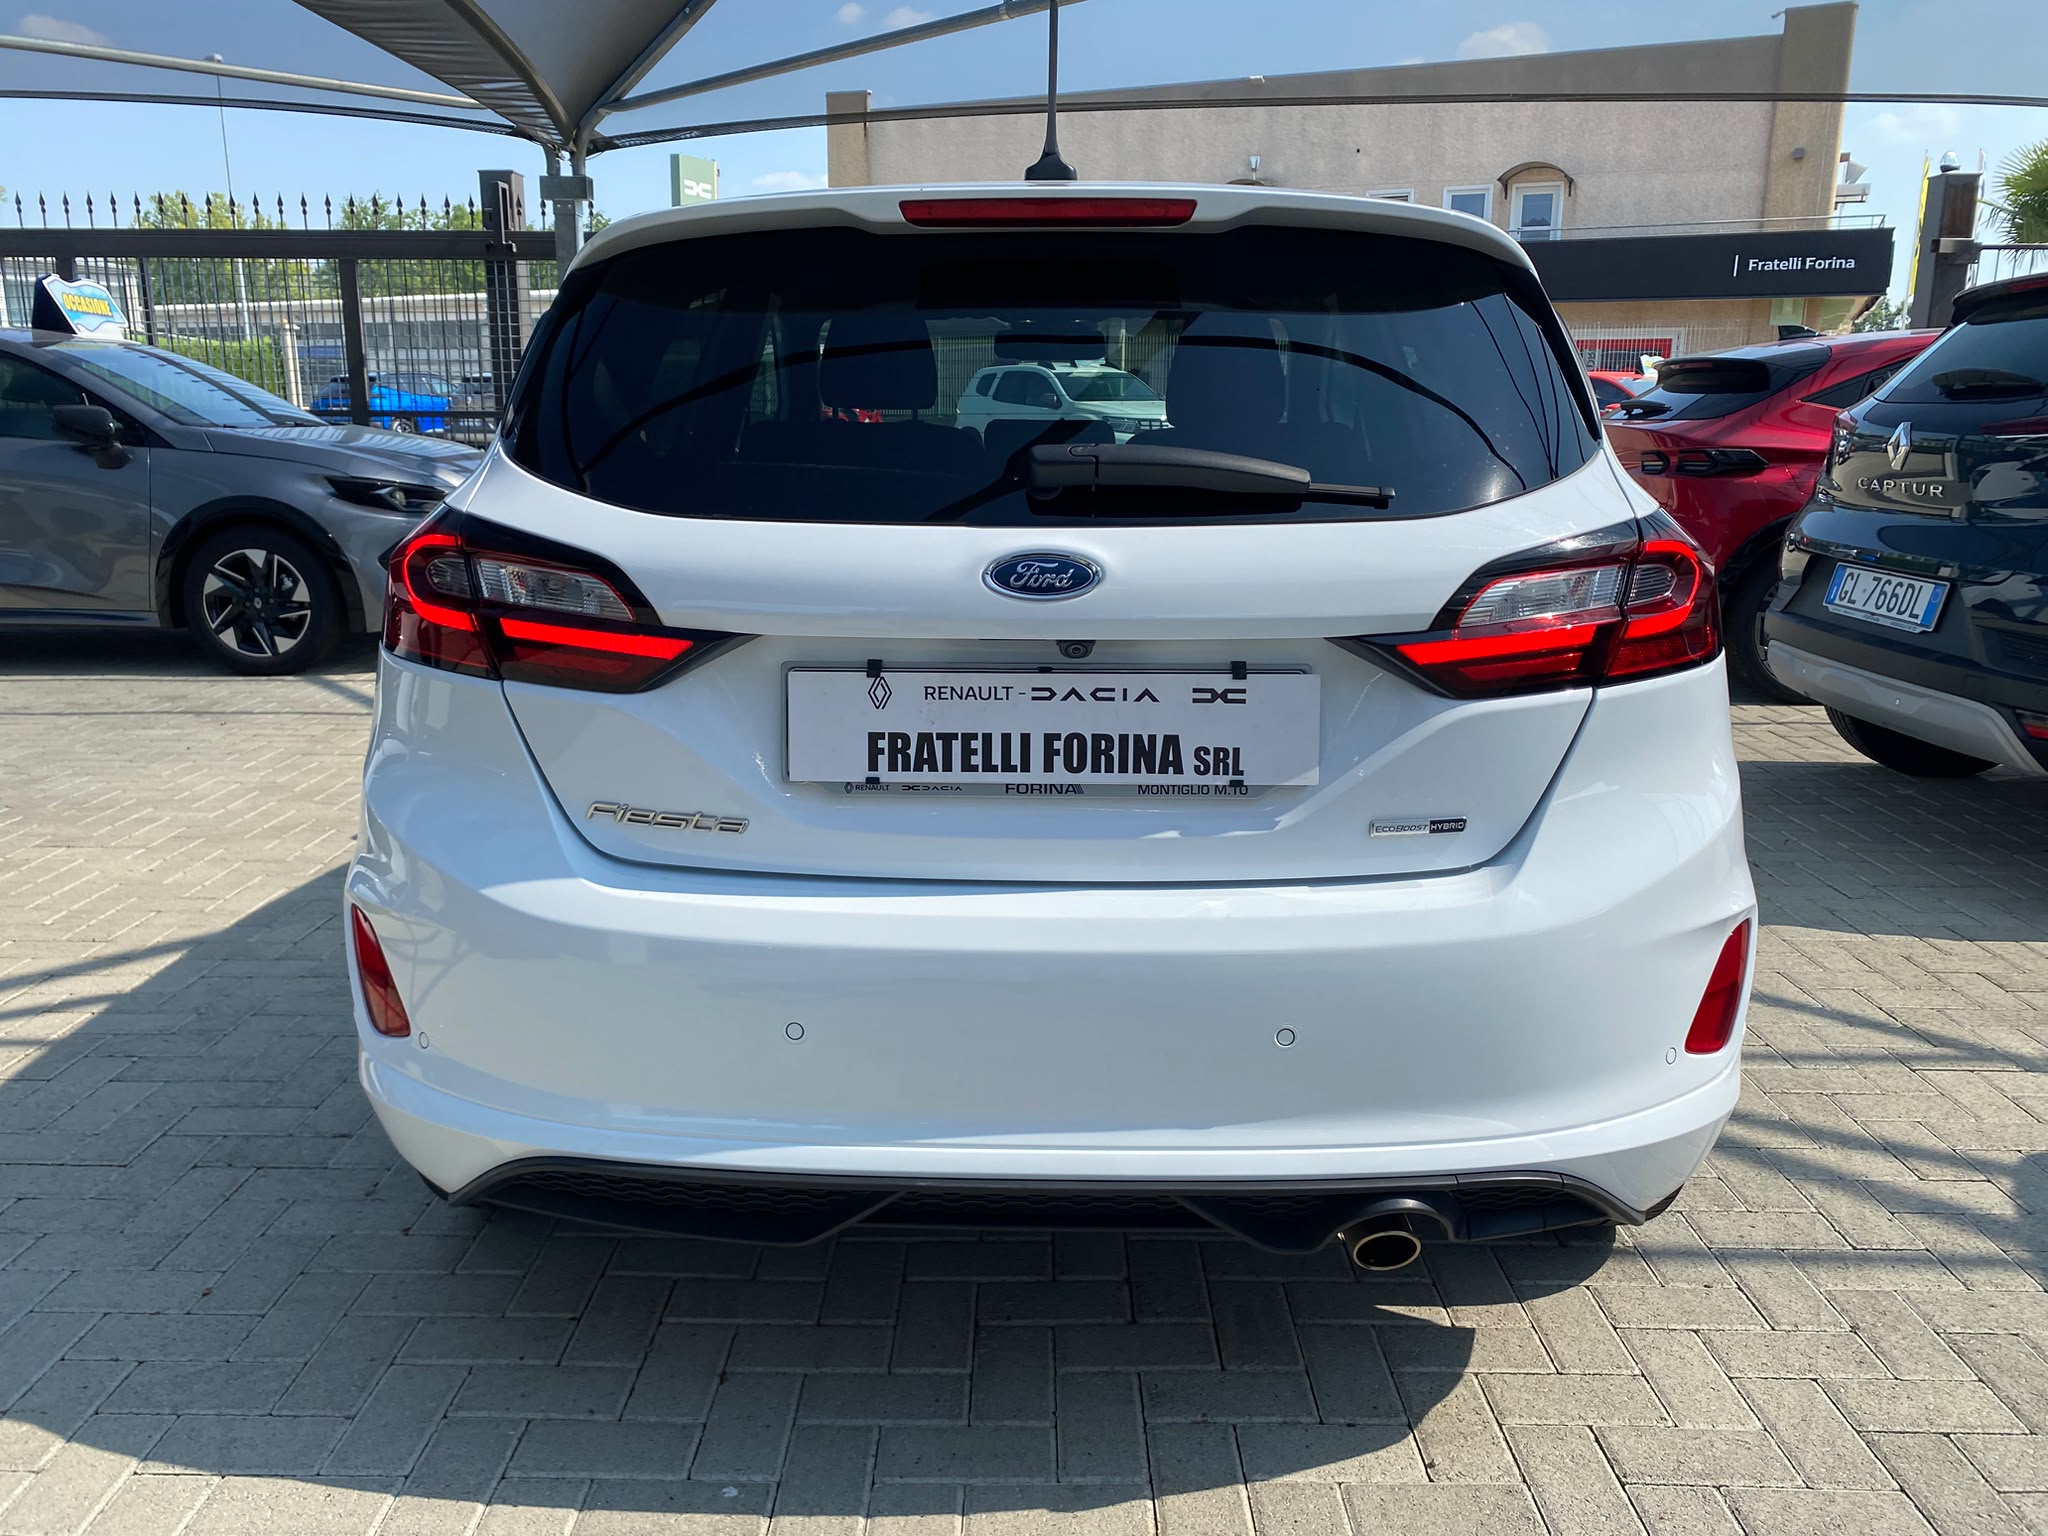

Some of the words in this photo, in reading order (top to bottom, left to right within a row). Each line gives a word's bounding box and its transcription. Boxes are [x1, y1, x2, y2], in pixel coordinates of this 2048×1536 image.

[1748, 257, 1802, 271] Fratelli
[1805, 256, 1856, 270] Forina
[62, 292, 113, 317] OCCASIONE
[1857, 477, 1944, 498] CAPTUR
[1009, 561, 1075, 588] Ford
[1838, 571, 1861, 605] GL
[1862, 575, 1924, 619] 766DL
[867, 731, 1031, 773] FRATELLI
[1043, 732, 1184, 775] FORINA
[1193, 746, 1244, 776] SRL
[855, 784, 890, 792] RENAULT
[1005, 783, 1078, 795] FORINA
[1137, 784, 1210, 795] MONTIGLIO
[586, 800, 750, 835] Fiesta
[1430, 821, 1466, 832] HYBRID
